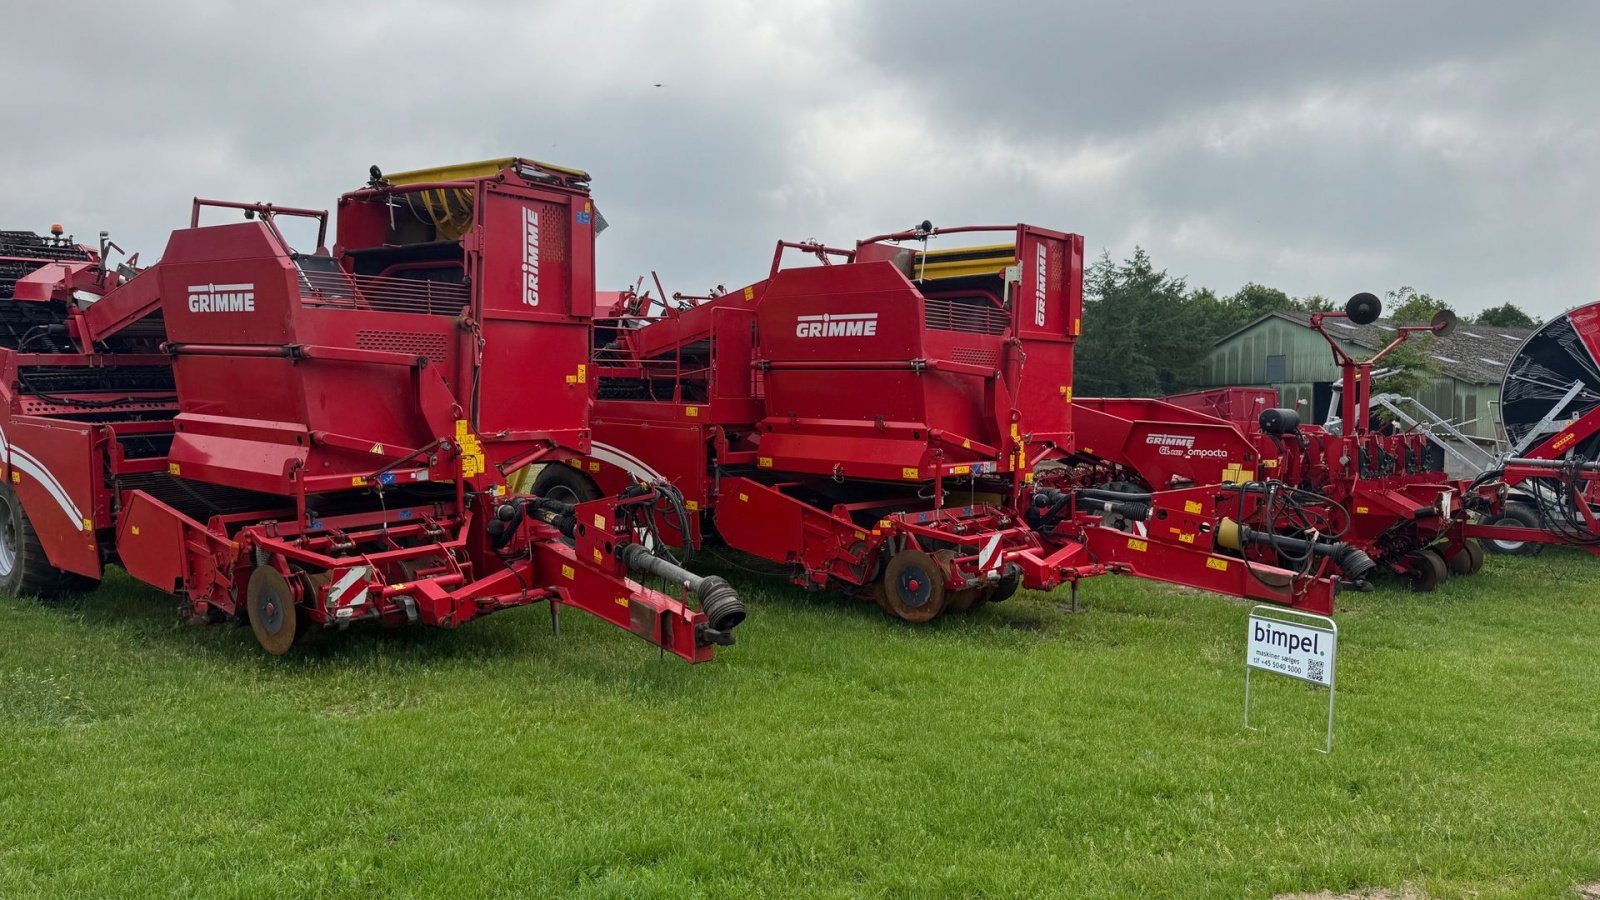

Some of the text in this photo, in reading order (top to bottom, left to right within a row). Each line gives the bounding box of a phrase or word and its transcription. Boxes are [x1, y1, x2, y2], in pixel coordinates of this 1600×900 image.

[522, 206, 538, 307] GRIMME
[1035, 242, 1046, 327] GRIMME
[188, 283, 254, 312] GRIMME
[796, 313, 878, 337] GRIMME
[1146, 433, 1195, 447] GRIMME
[1256, 650, 1300, 665] maskiner sælges
[1272, 662, 1286, 671] 5040
[1288, 665, 1302, 675] 5000
